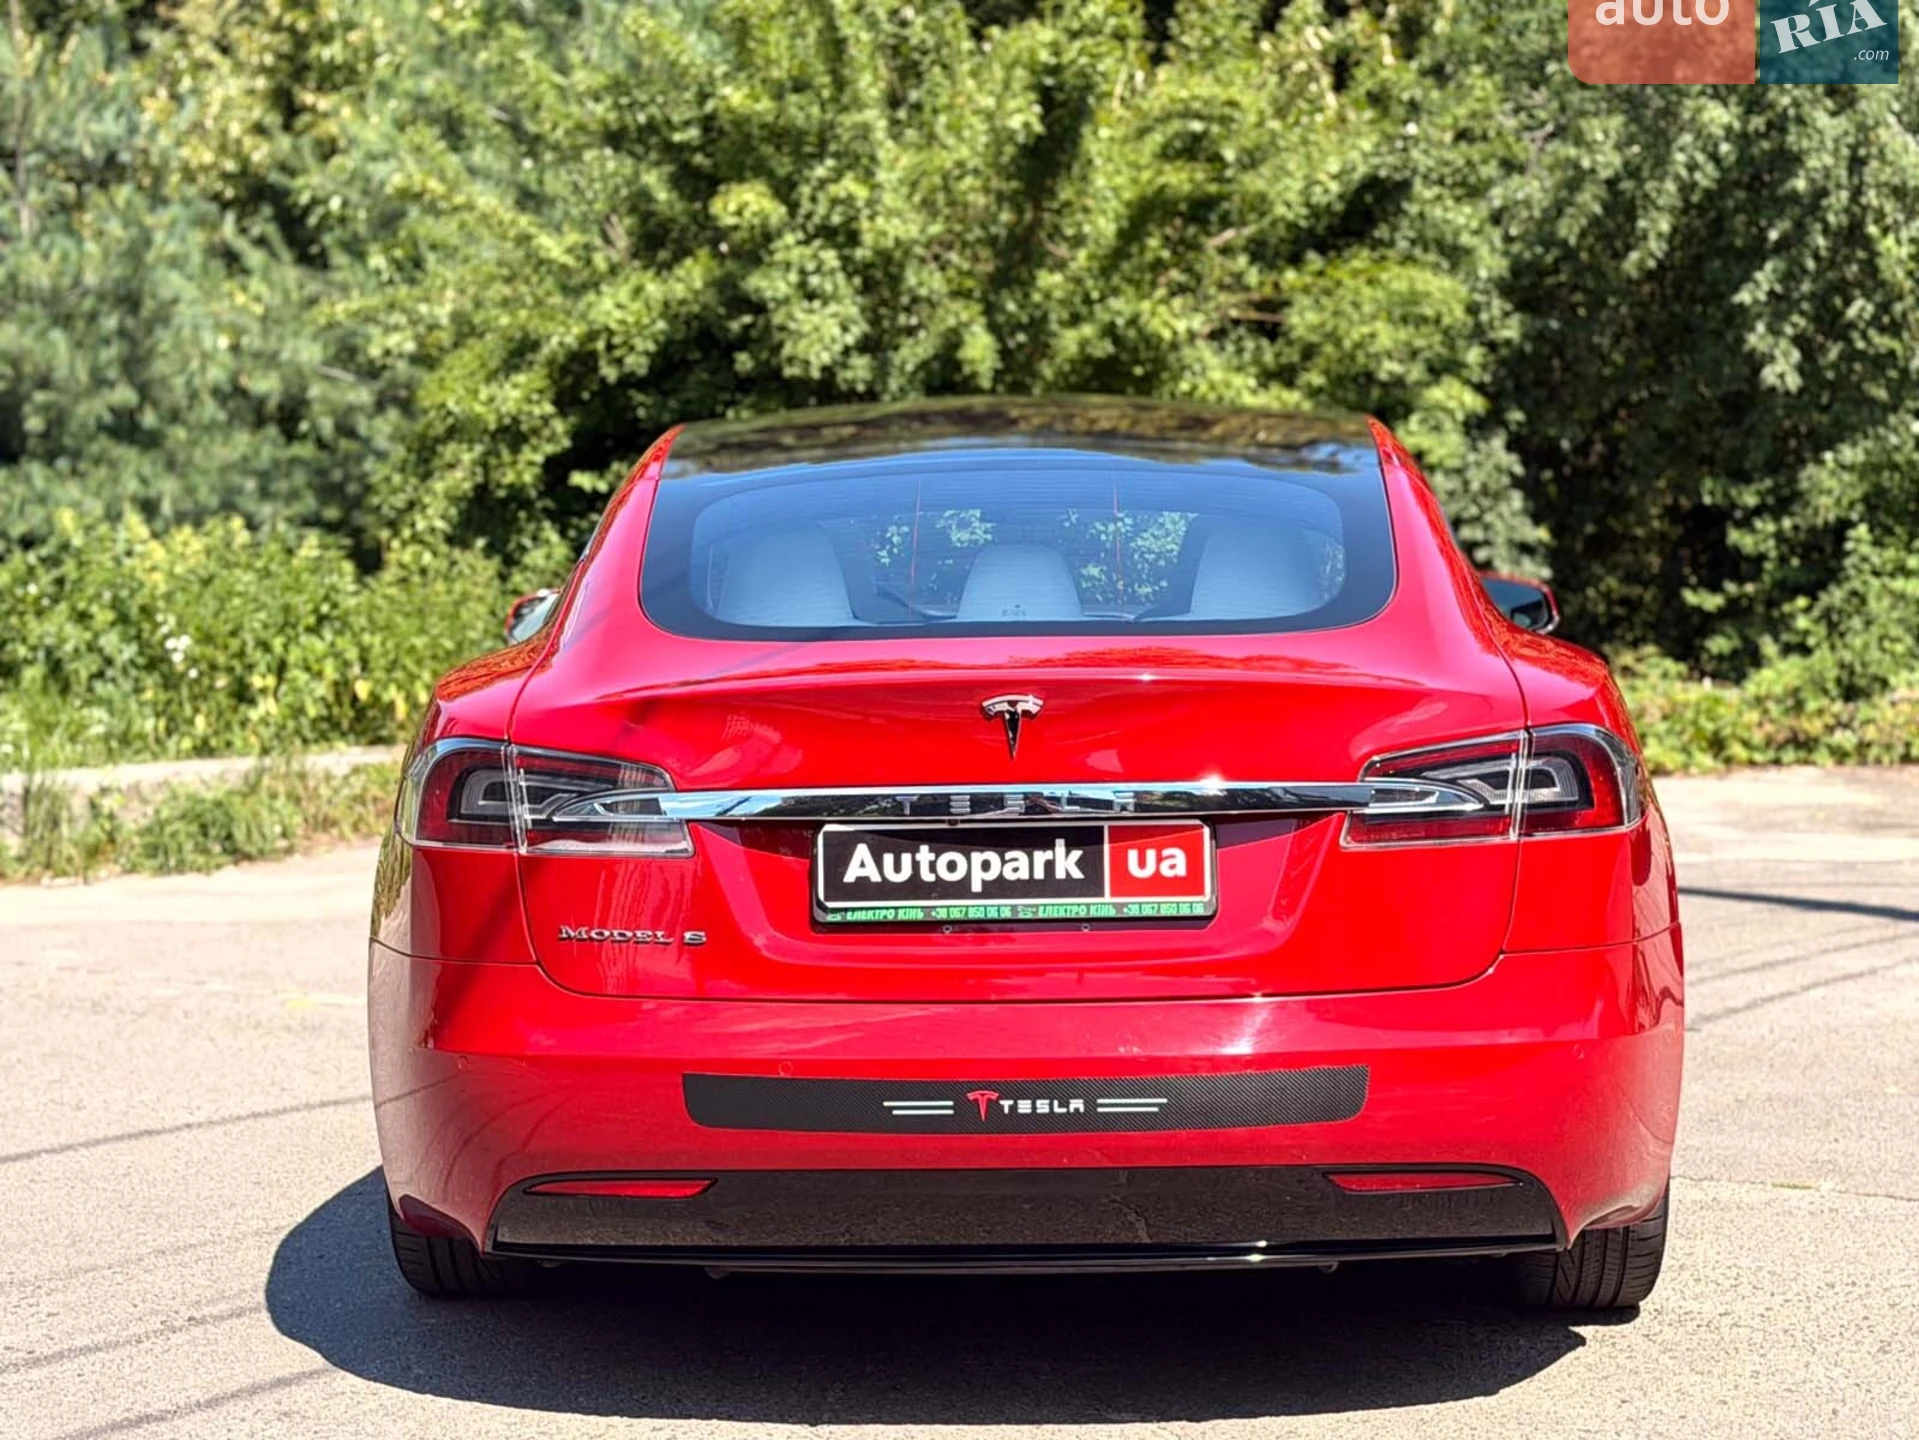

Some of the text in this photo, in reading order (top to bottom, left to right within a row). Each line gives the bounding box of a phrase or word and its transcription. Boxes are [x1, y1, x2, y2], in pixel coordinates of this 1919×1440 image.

[842, 838, 1187, 892] Autopark ua
[557, 925, 707, 946] MODEL S
[999, 1099, 1084, 1114] TESLA
